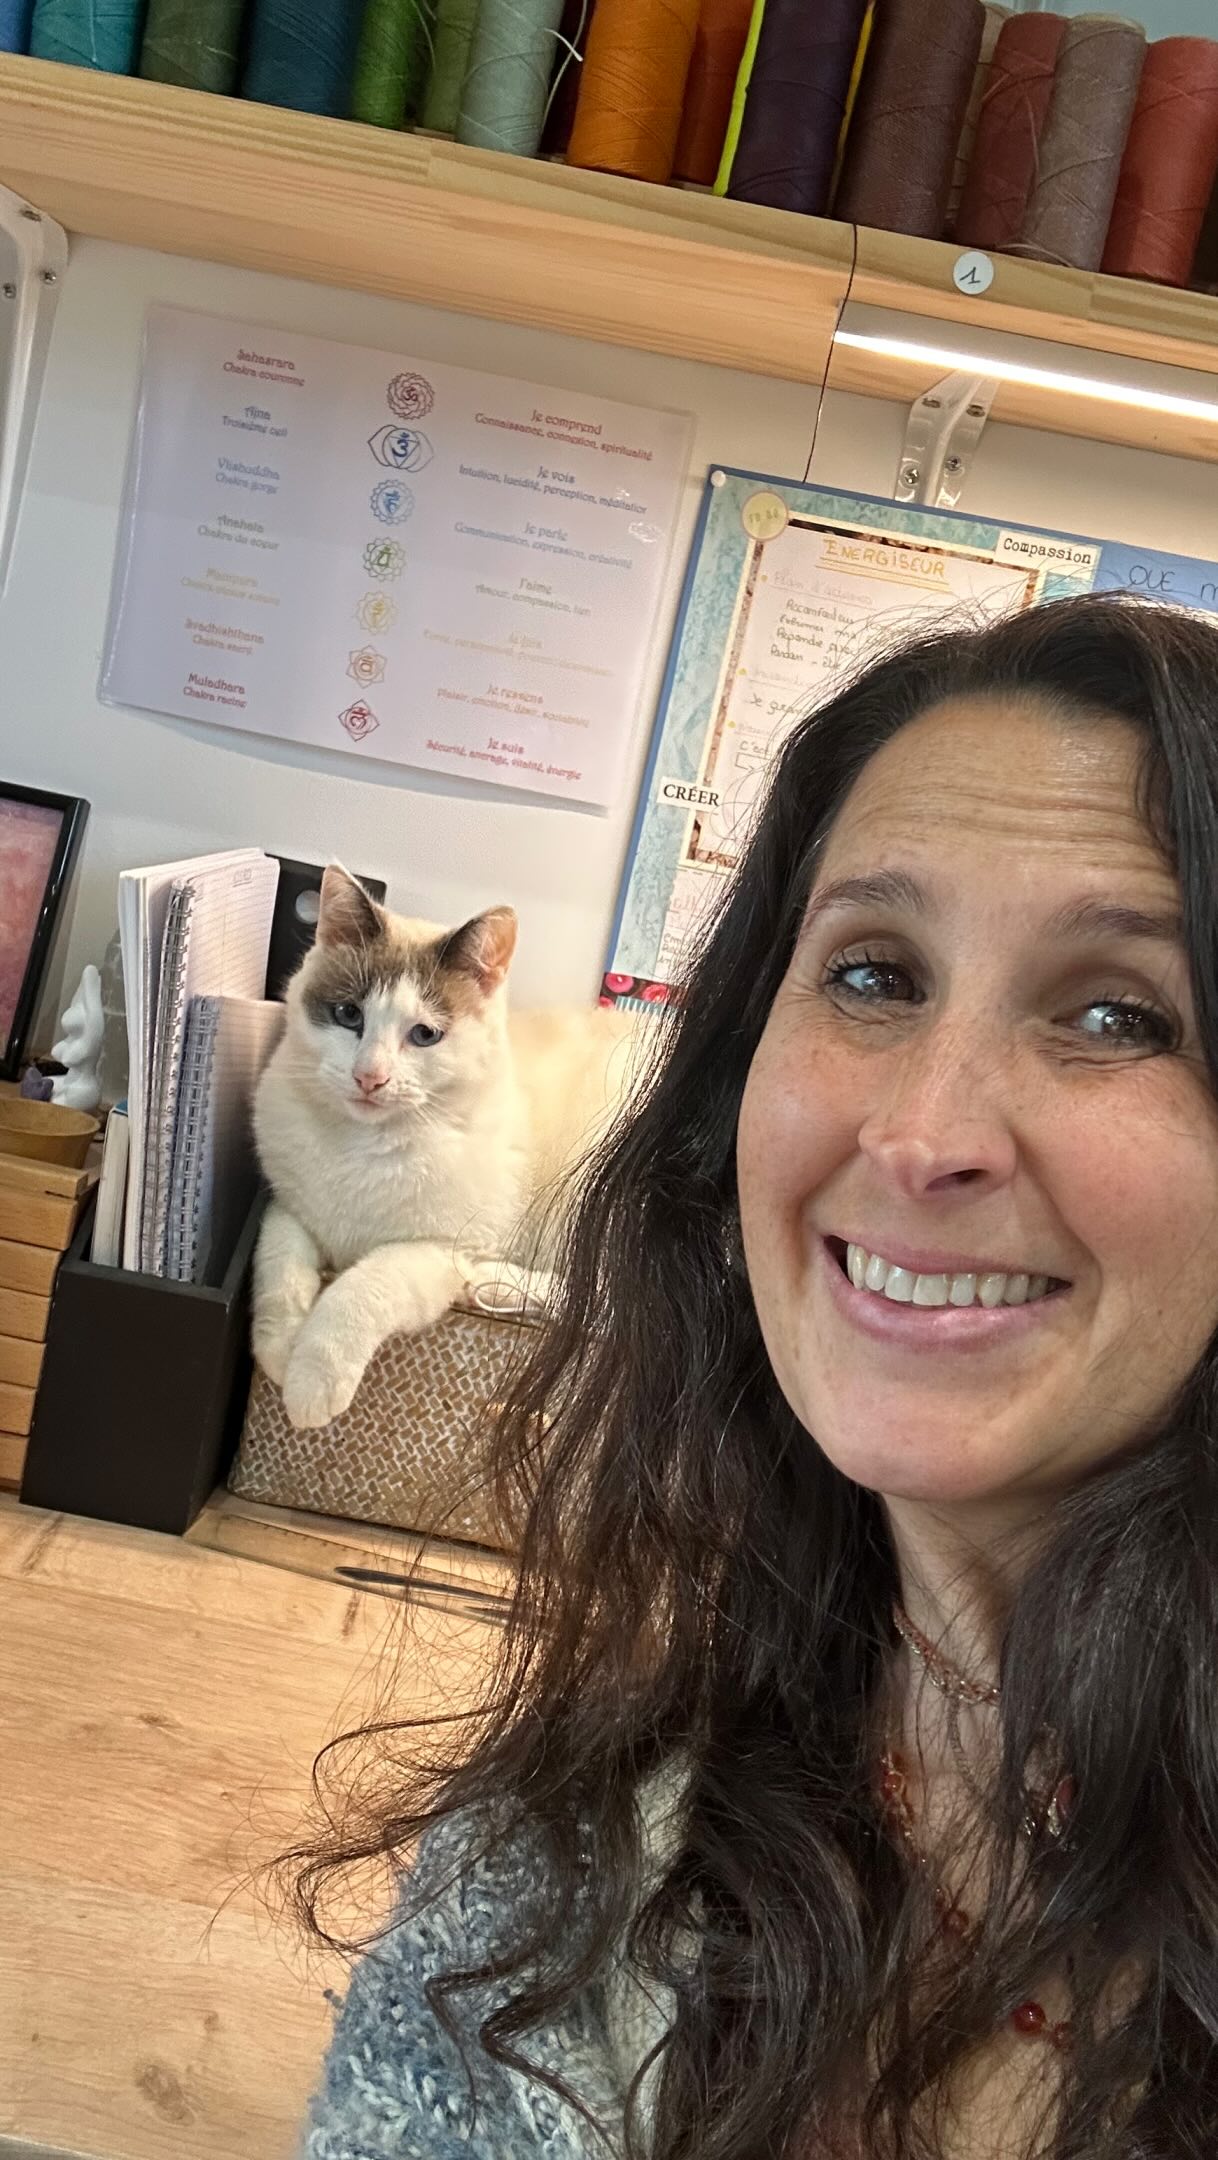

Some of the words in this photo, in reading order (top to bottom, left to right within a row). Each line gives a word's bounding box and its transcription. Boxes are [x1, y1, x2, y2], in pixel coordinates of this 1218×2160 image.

[958, 266, 981, 285] 1
[545, 415, 602, 436] comprend
[551, 471, 576, 485] vois
[1002, 537, 1092, 565] Compassion
[662, 783, 720, 808] CRÉER
